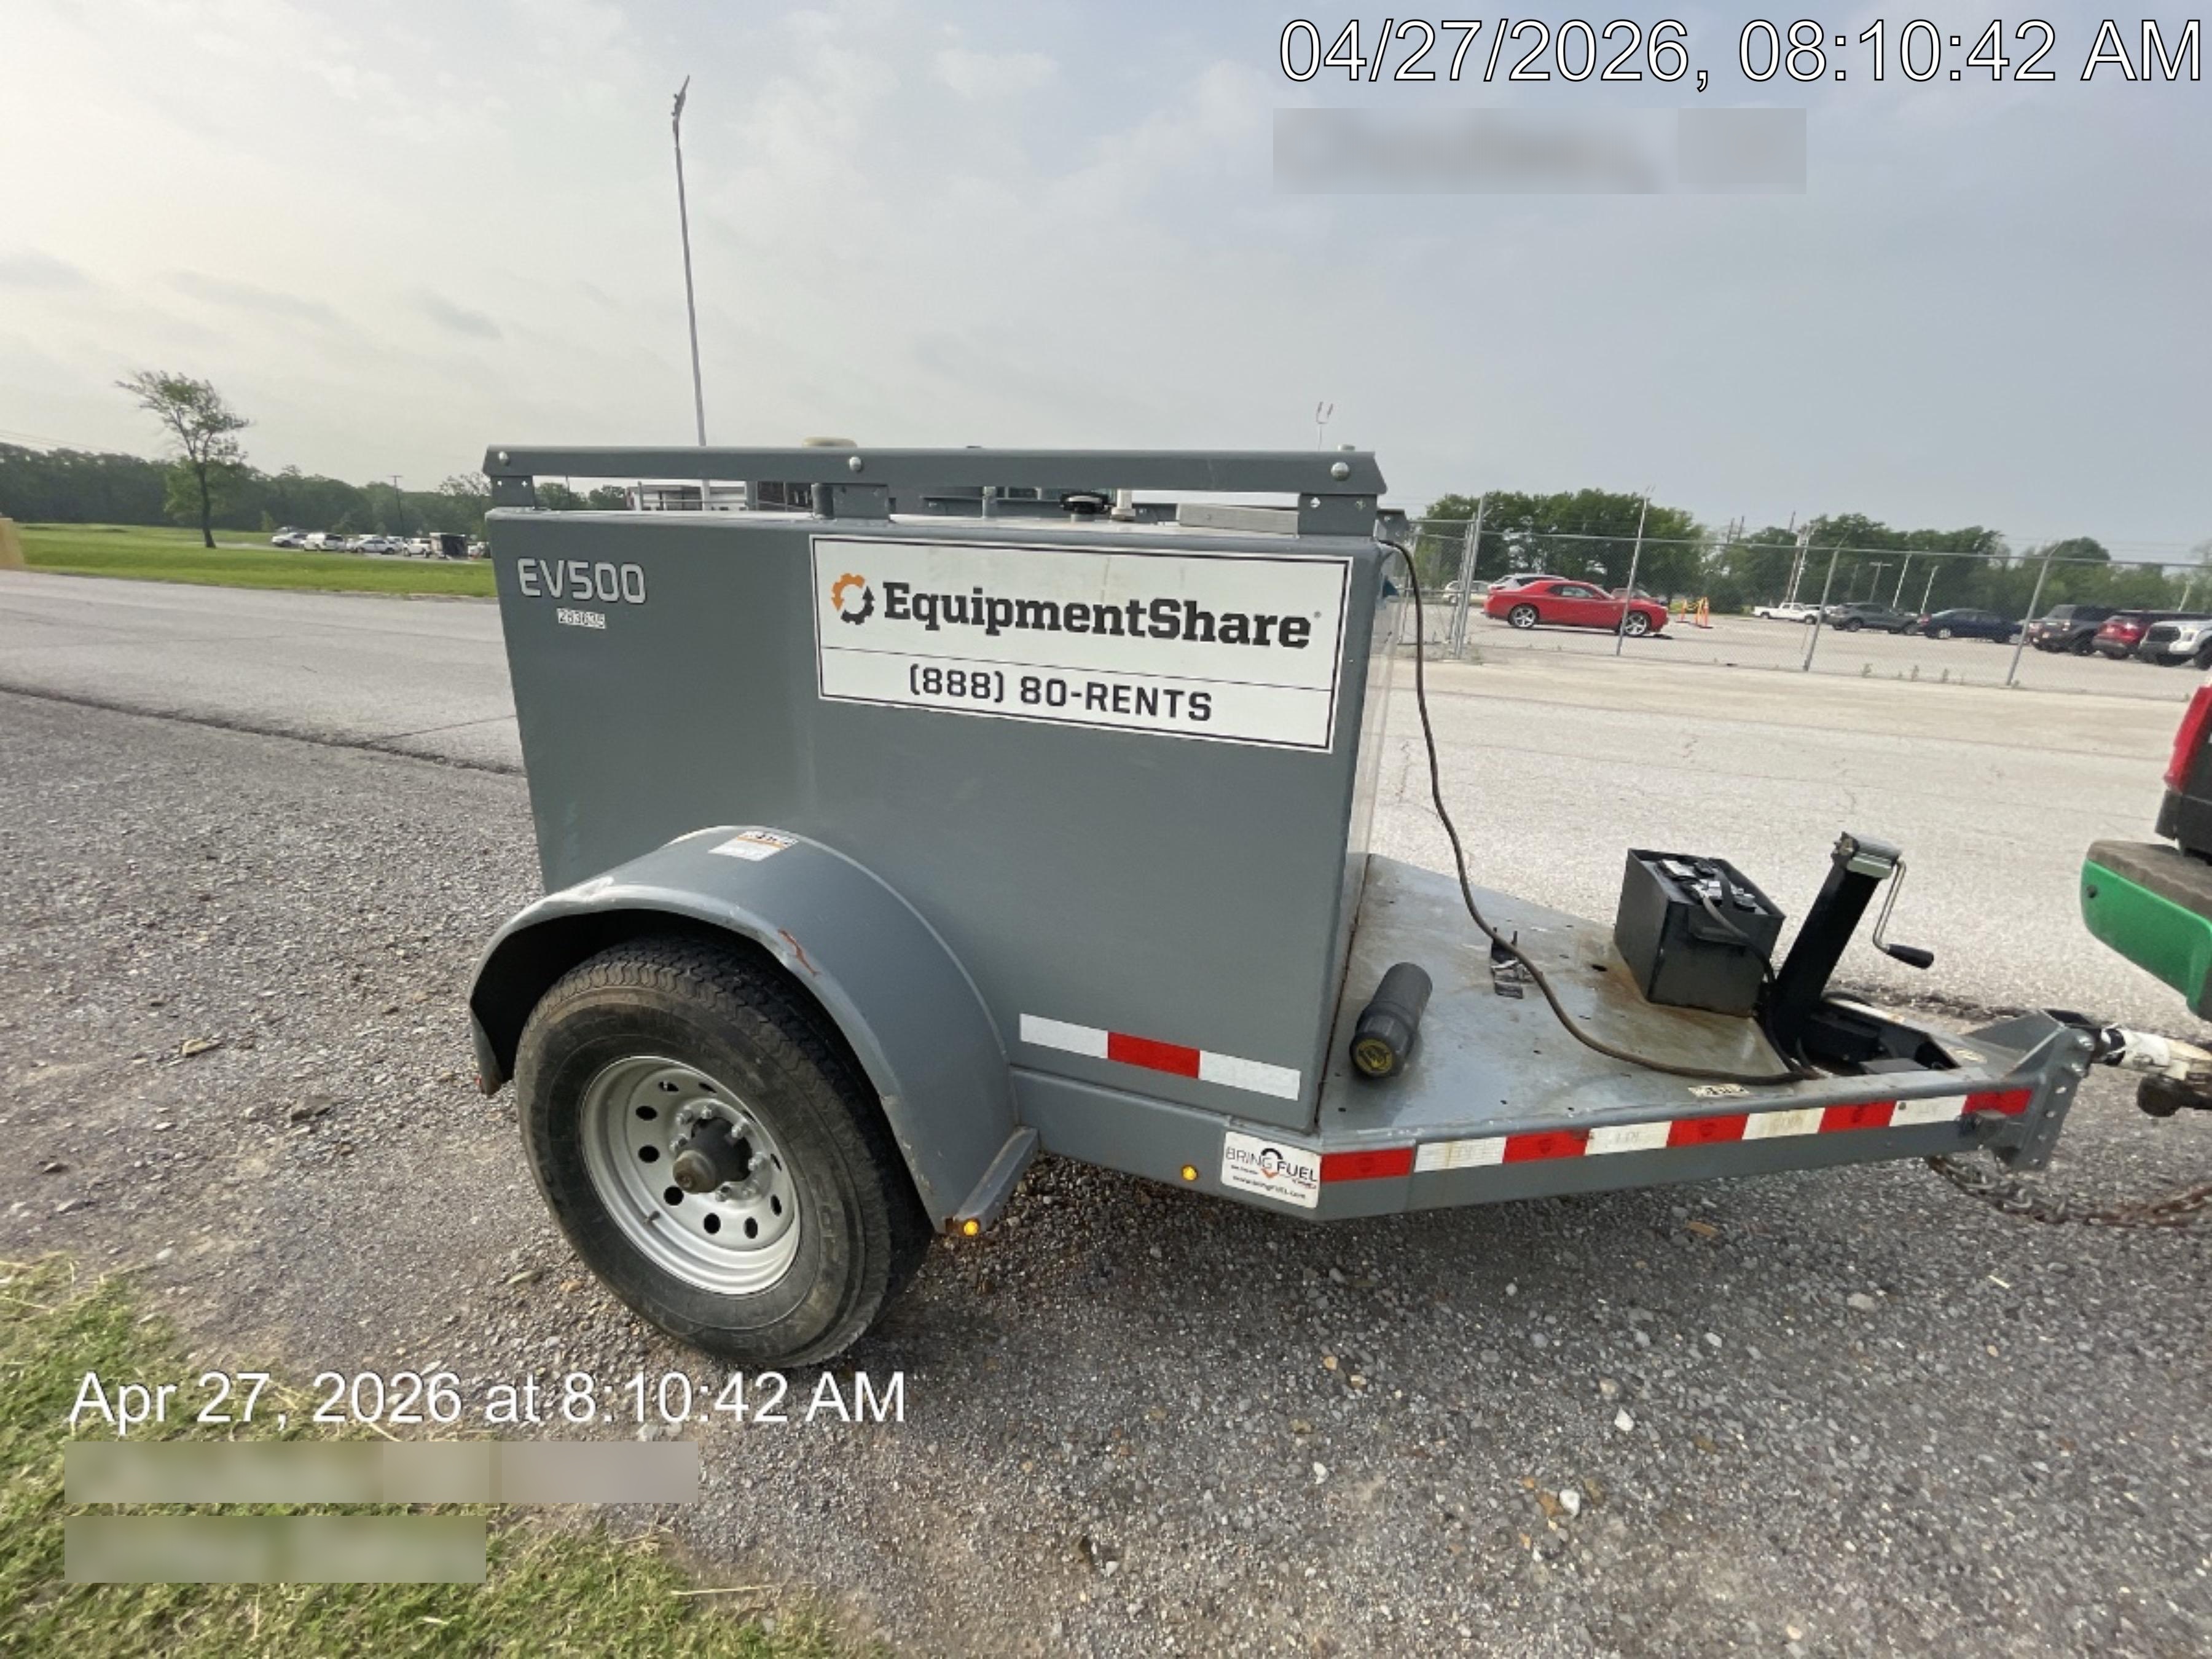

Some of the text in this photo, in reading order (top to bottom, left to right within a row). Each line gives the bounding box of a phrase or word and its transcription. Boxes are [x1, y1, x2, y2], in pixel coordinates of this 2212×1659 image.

[517, 558, 646, 604] EV500
[883, 581, 1311, 649] EquipmentShare
[909, 664, 1212, 722] (888) 80-RENTS
[1226, 1147, 1272, 1169] BRING
[1277, 1161, 1319, 1182] FUEL
